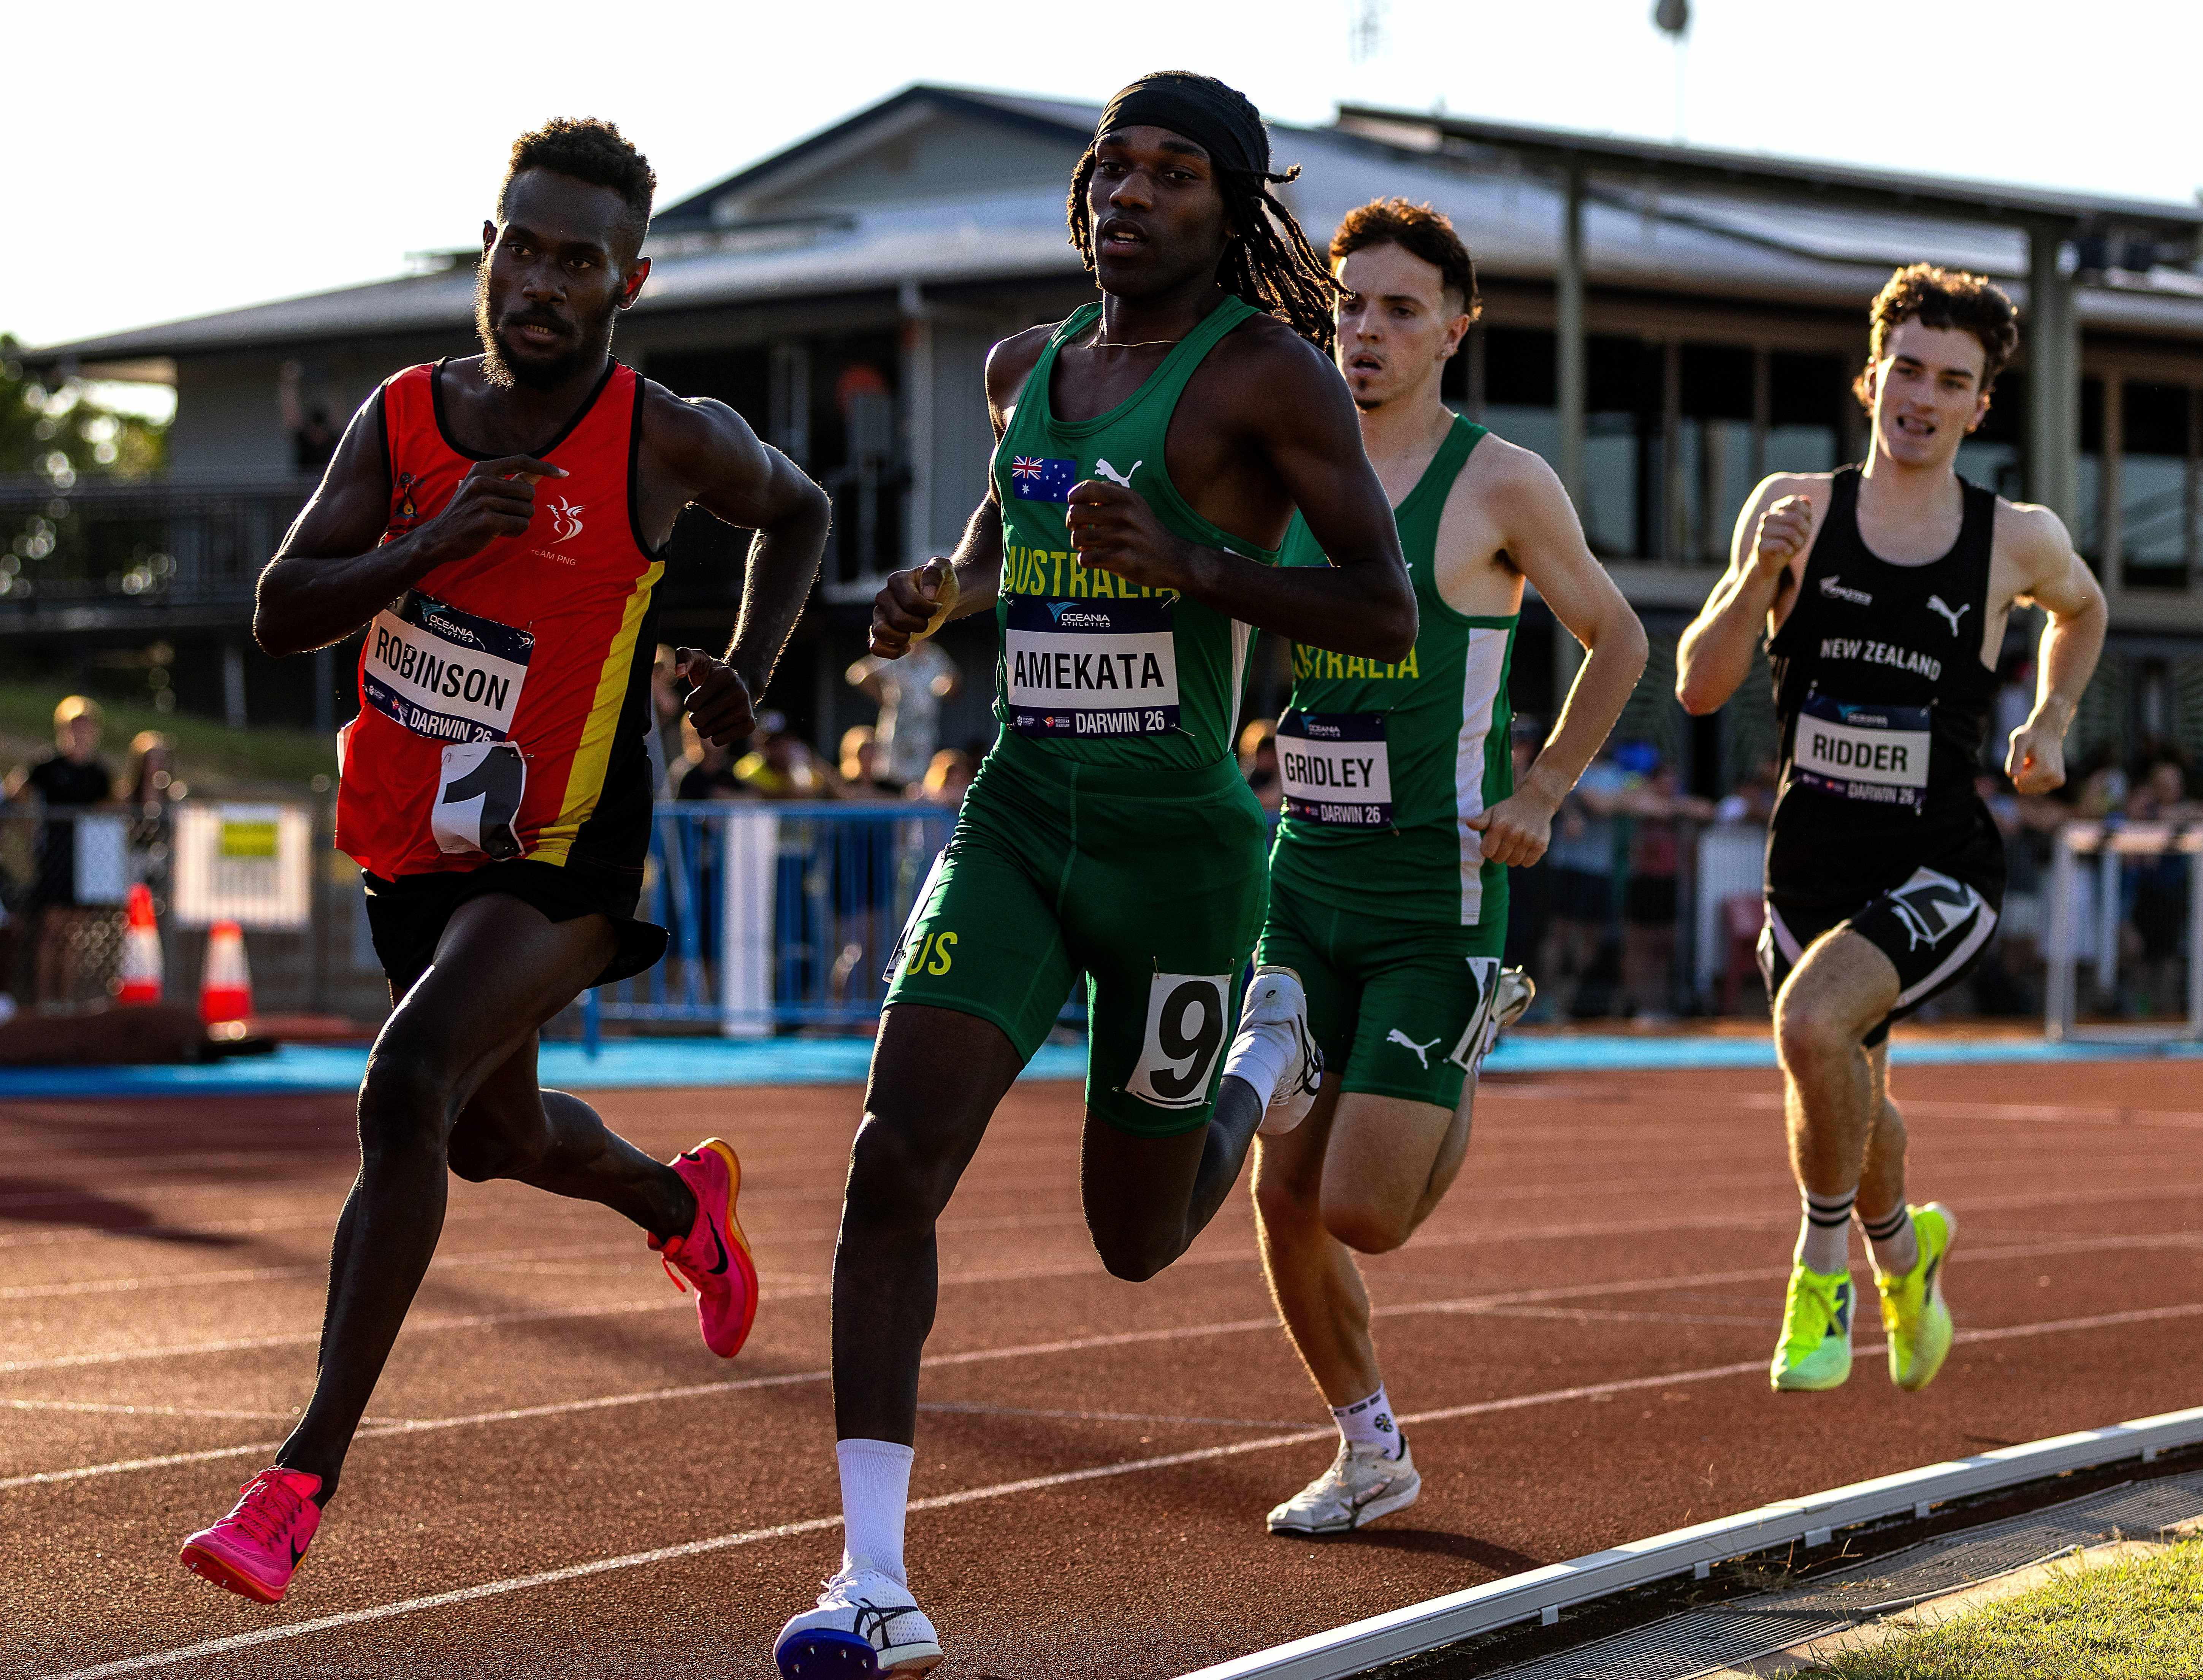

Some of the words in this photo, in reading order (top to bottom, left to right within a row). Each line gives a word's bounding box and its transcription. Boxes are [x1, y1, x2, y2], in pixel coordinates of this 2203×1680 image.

[557, 555, 577, 565] PNG
[1005, 546, 1180, 599] AUSTRAL
[428, 622, 474, 643] ATHLETICS
[430, 614, 474, 638] OCEANIA
[1062, 613, 1109, 622] OCEANIA
[375, 627, 510, 711] ROBINSON
[1014, 651, 1165, 690] AMEKATA
[1819, 638, 1862, 659] NEW
[1863, 640, 1941, 681] ZEALAND
[409, 708, 471, 741] DARWIN
[472, 727, 492, 743] 26
[1076, 712, 1140, 733] DARWIN
[1145, 711, 1165, 730] 26
[1285, 752, 1374, 787] GRIDLEY
[1813, 734, 1907, 772] RIDDER
[442, 746, 523, 860] 1
[1320, 803, 1363, 823] DARWIN
[1365, 806, 1381, 823] 26
[907, 931, 958, 975] US
[1149, 980, 1223, 1099] 9
